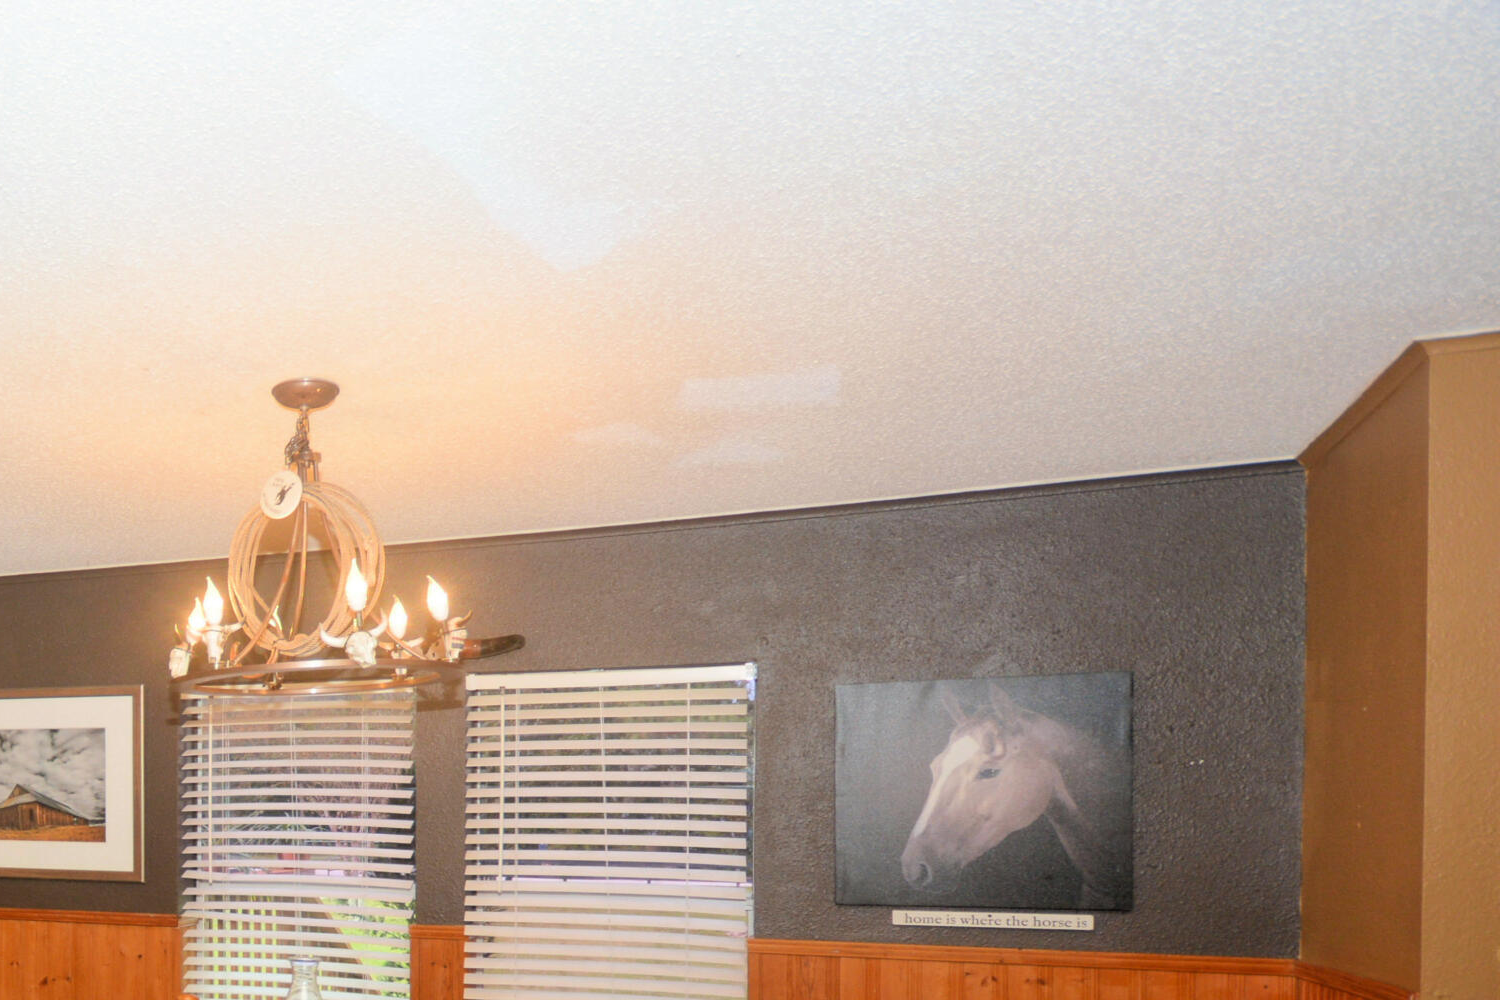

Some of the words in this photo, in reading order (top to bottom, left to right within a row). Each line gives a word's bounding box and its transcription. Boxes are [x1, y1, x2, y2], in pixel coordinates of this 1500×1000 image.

[904, 912, 942, 925] home
[946, 913, 958, 926] is
[960, 914, 1002, 926] where
[1006, 915, 1029, 927] the
[1033, 916, 1073, 928] horse
[1076, 917, 1088, 929] is
